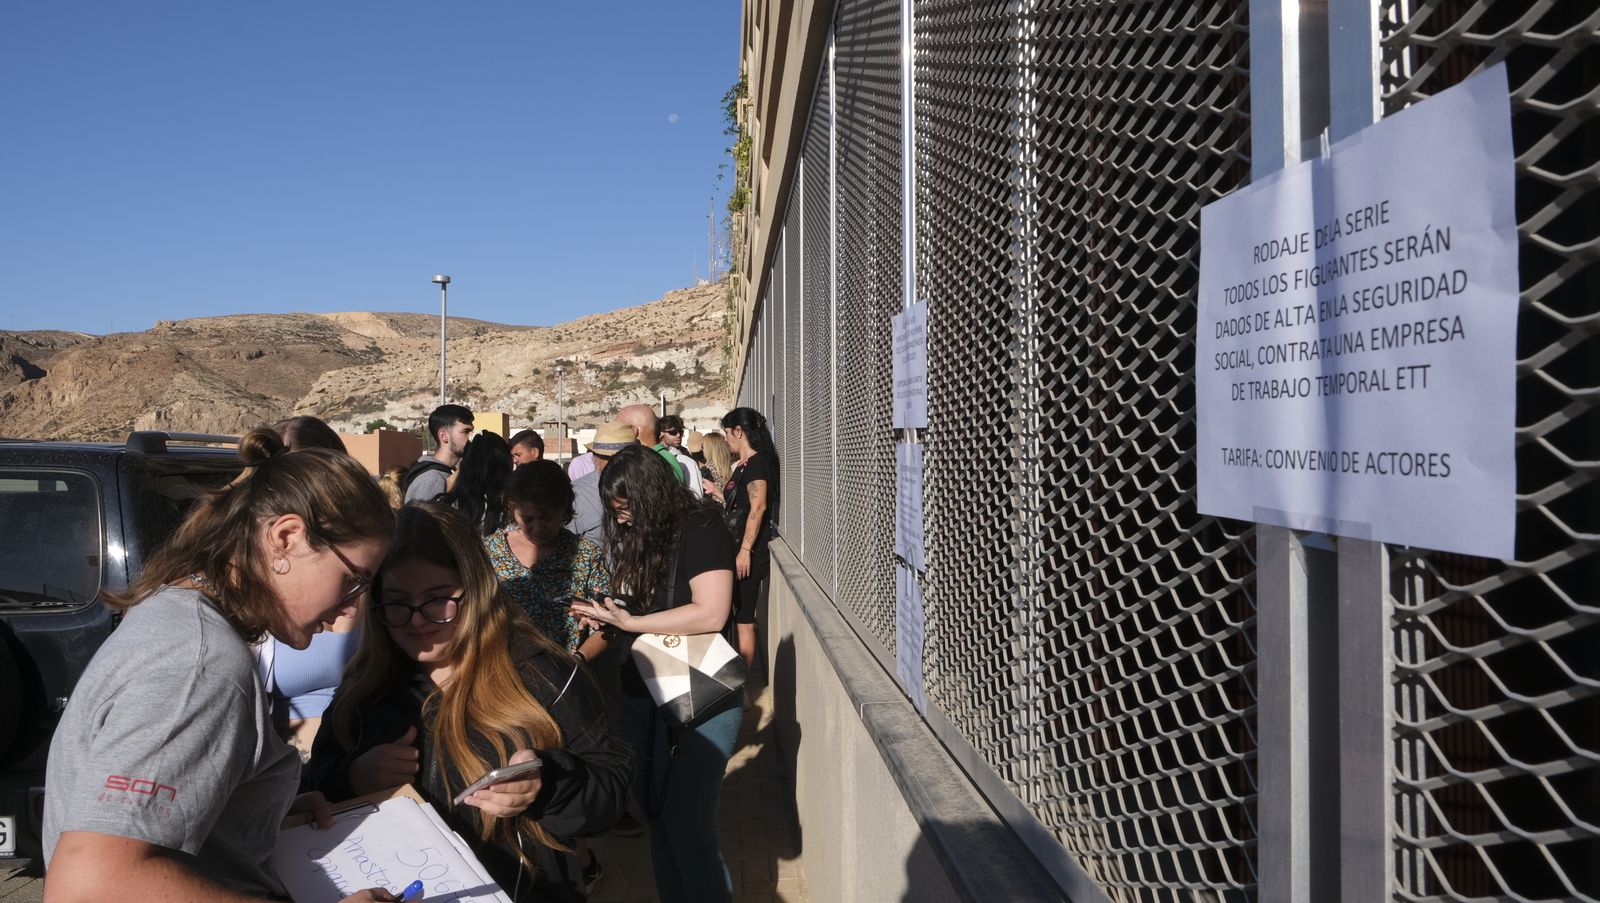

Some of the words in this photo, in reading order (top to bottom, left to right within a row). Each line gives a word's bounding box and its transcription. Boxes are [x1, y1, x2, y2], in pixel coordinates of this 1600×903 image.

[1253, 232, 1310, 265] RODAJE
[1315, 228, 1329, 249] DE
[1329, 223, 1341, 244] LA
[1346, 200, 1391, 237] SERIE
[1224, 281, 1260, 306] TODOS
[1263, 272, 1288, 296] LOS
[1294, 246, 1378, 290] FIGURANTES
[1384, 224, 1451, 265] SERÁN
[1215, 315, 1252, 339] DADOS
[1255, 311, 1270, 332] DE
[1274, 304, 1316, 329] ALTA
[1320, 301, 1332, 321] EN
[1333, 295, 1348, 318] LA
[1352, 269, 1468, 314] SEGURIDAD
[1214, 347, 1254, 371] SOCIAL,
[1257, 338, 1333, 365] CONTRATA
[1335, 331, 1365, 356] UNA
[1371, 315, 1465, 351] EMPRESA
[1231, 382, 1246, 401] DE
[1248, 377, 1311, 400] TRABAJO
[1315, 370, 1390, 398] TEMPORAL
[1397, 364, 1432, 390] ETT
[1221, 447, 1263, 468] TARIFA:
[1265, 449, 1338, 472] CONVENIO
[1341, 452, 1360, 473] DE
[1365, 452, 1452, 478] ACTORES
